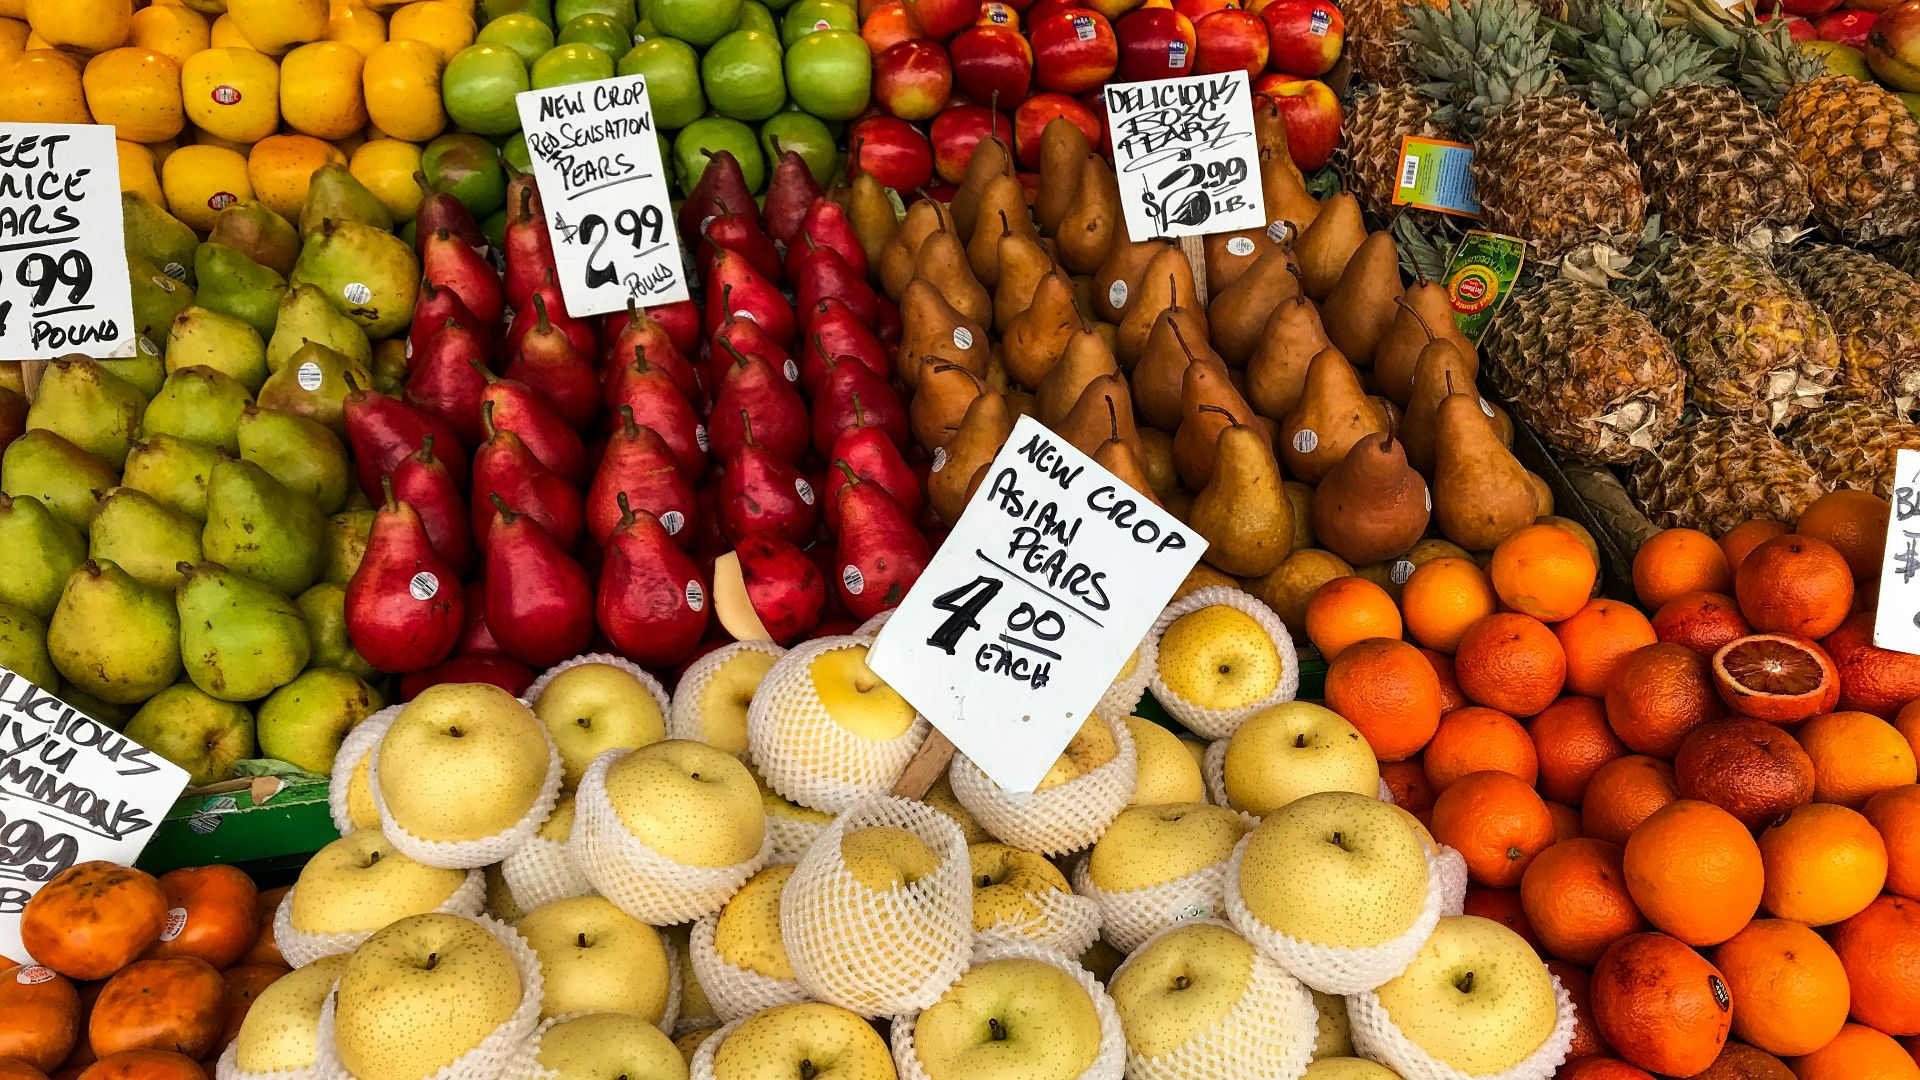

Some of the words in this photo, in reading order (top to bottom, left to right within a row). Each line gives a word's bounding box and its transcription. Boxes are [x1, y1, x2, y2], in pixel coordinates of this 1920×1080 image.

[540, 91, 585, 122] NEW
[593, 81, 645, 112] CROP
[1106, 74, 1241, 114] DELICIOUS
[528, 131, 560, 160] RED
[560, 111, 651, 150] SENSATION
[1117, 101, 1217, 136] BOSC
[1117, 113, 1230, 159] PEARS
[0, 134, 71, 170] EET
[553, 153, 636, 191] PEARS
[0, 203, 80, 238] ARS
[623, 262, 673, 298] POUND
[30, 318, 119, 351] POUND
[987, 467, 1083, 547] ASIAN
[1017, 433, 1084, 490] NEW
[1087, 486, 1187, 553] CROP
[1008, 526, 1111, 611] PEARS
[975, 643, 1051, 690] EACH
[0, 671, 161, 776] LICIOUS
[0, 713, 78, 774] YU
[0, 757, 153, 841] MMONS
